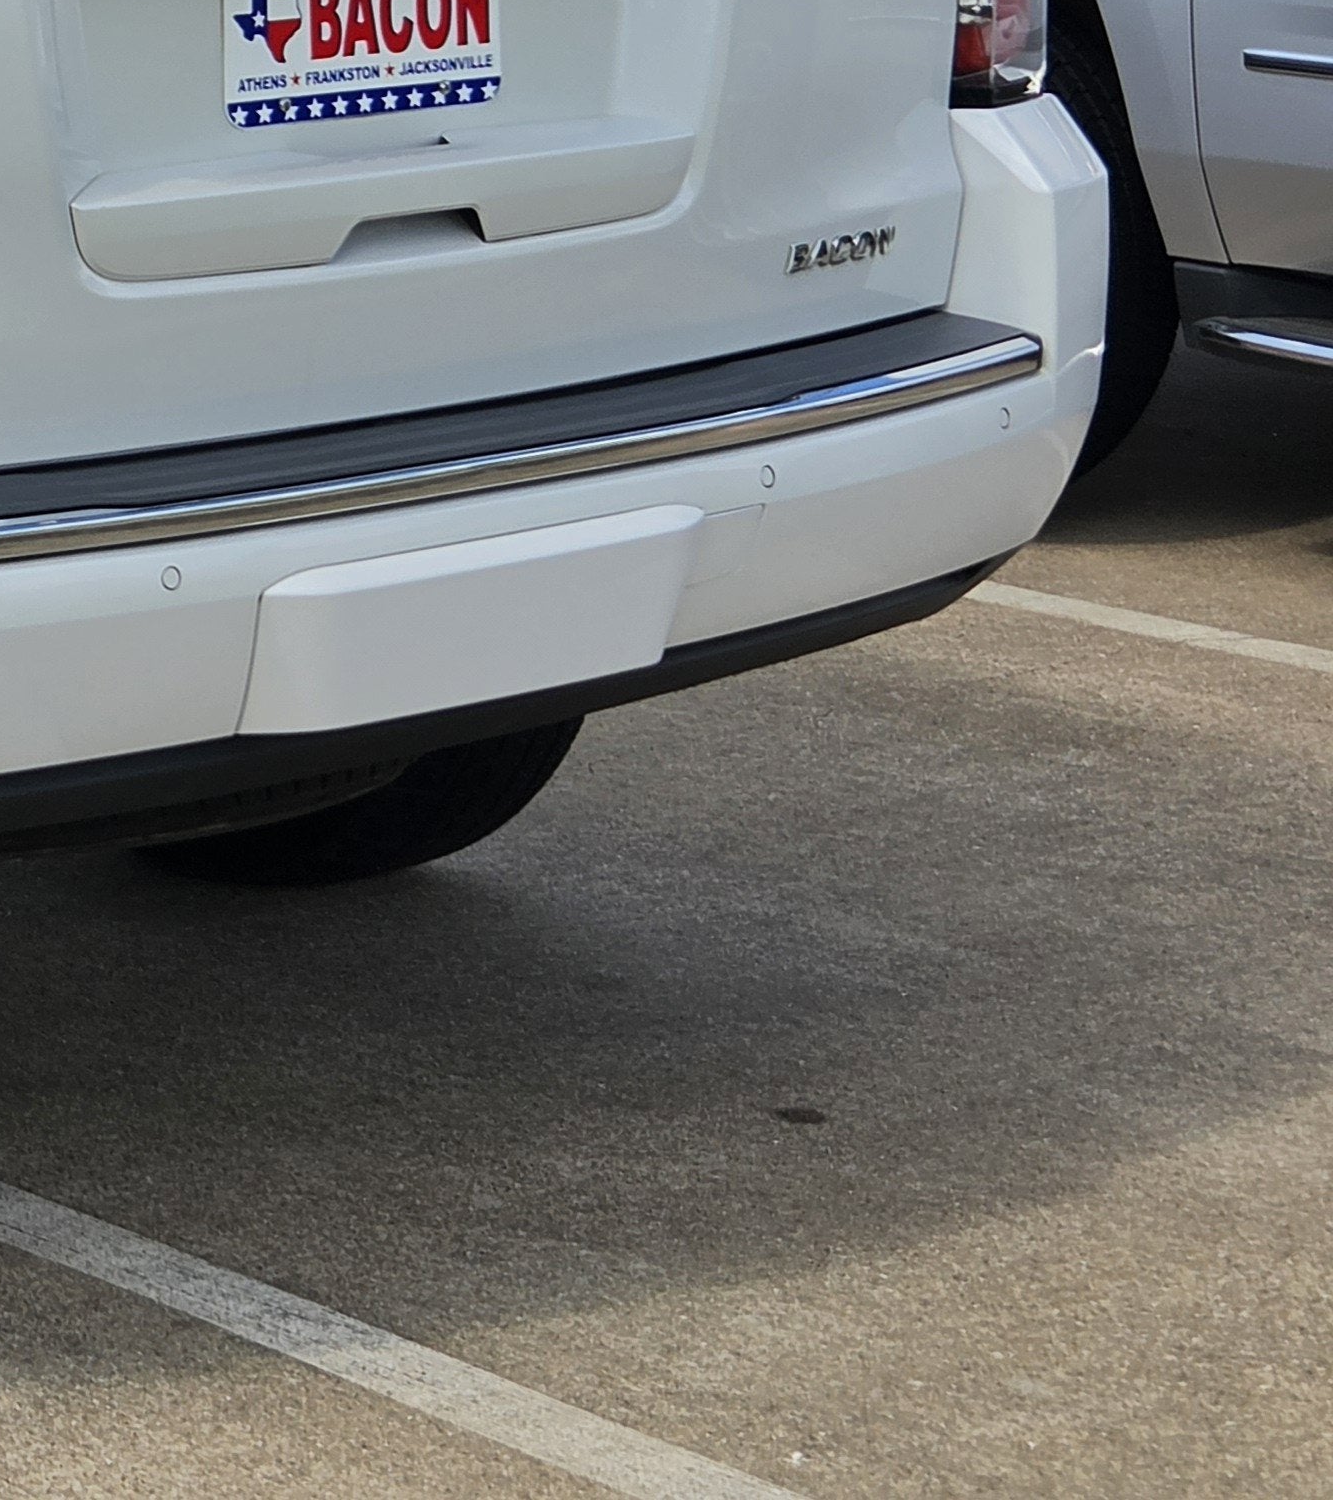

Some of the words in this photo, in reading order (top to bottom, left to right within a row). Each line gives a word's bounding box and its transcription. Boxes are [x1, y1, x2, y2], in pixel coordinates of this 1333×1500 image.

[237, 74, 288, 93] ATHENS
[305, 65, 381, 86] FRANKSTON
[398, 54, 494, 76] JACKSONVILLE
[784, 225, 897, 276] BACON
